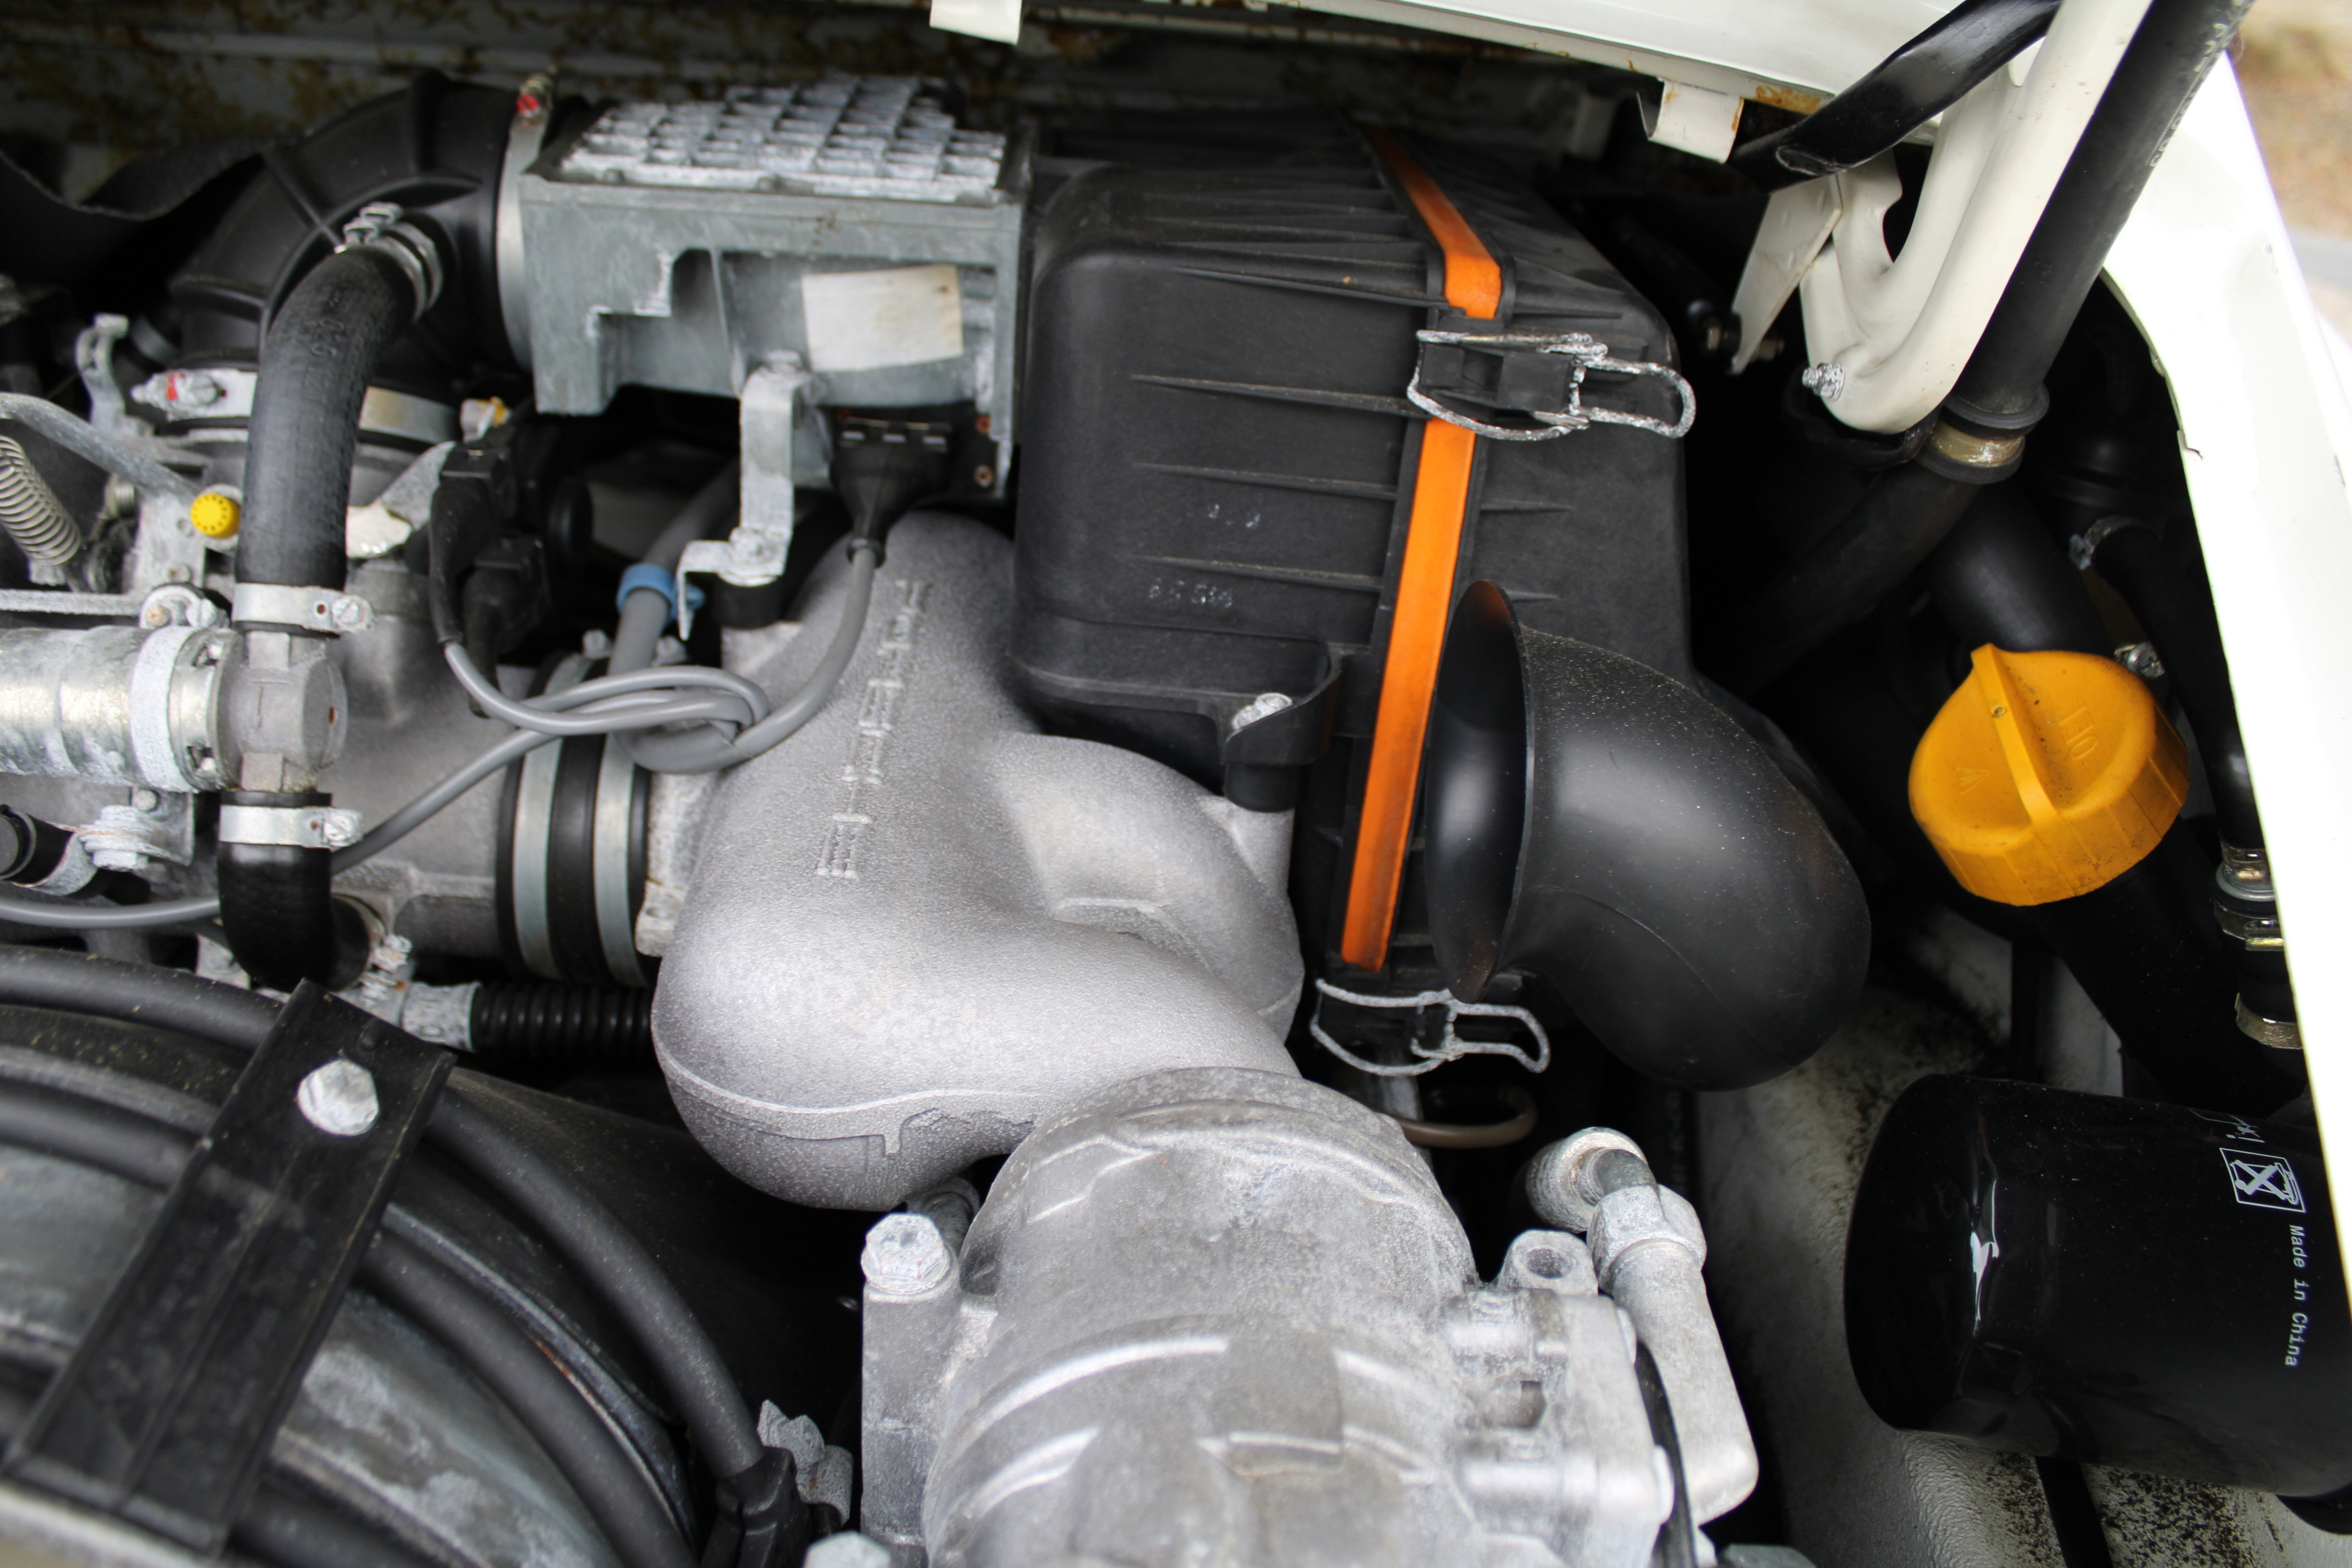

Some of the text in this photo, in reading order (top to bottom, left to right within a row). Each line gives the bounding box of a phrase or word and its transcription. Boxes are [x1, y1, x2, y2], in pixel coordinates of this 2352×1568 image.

[2058, 695, 2098, 760] OEL
[2285, 1224, 2309, 1366] Made in China
